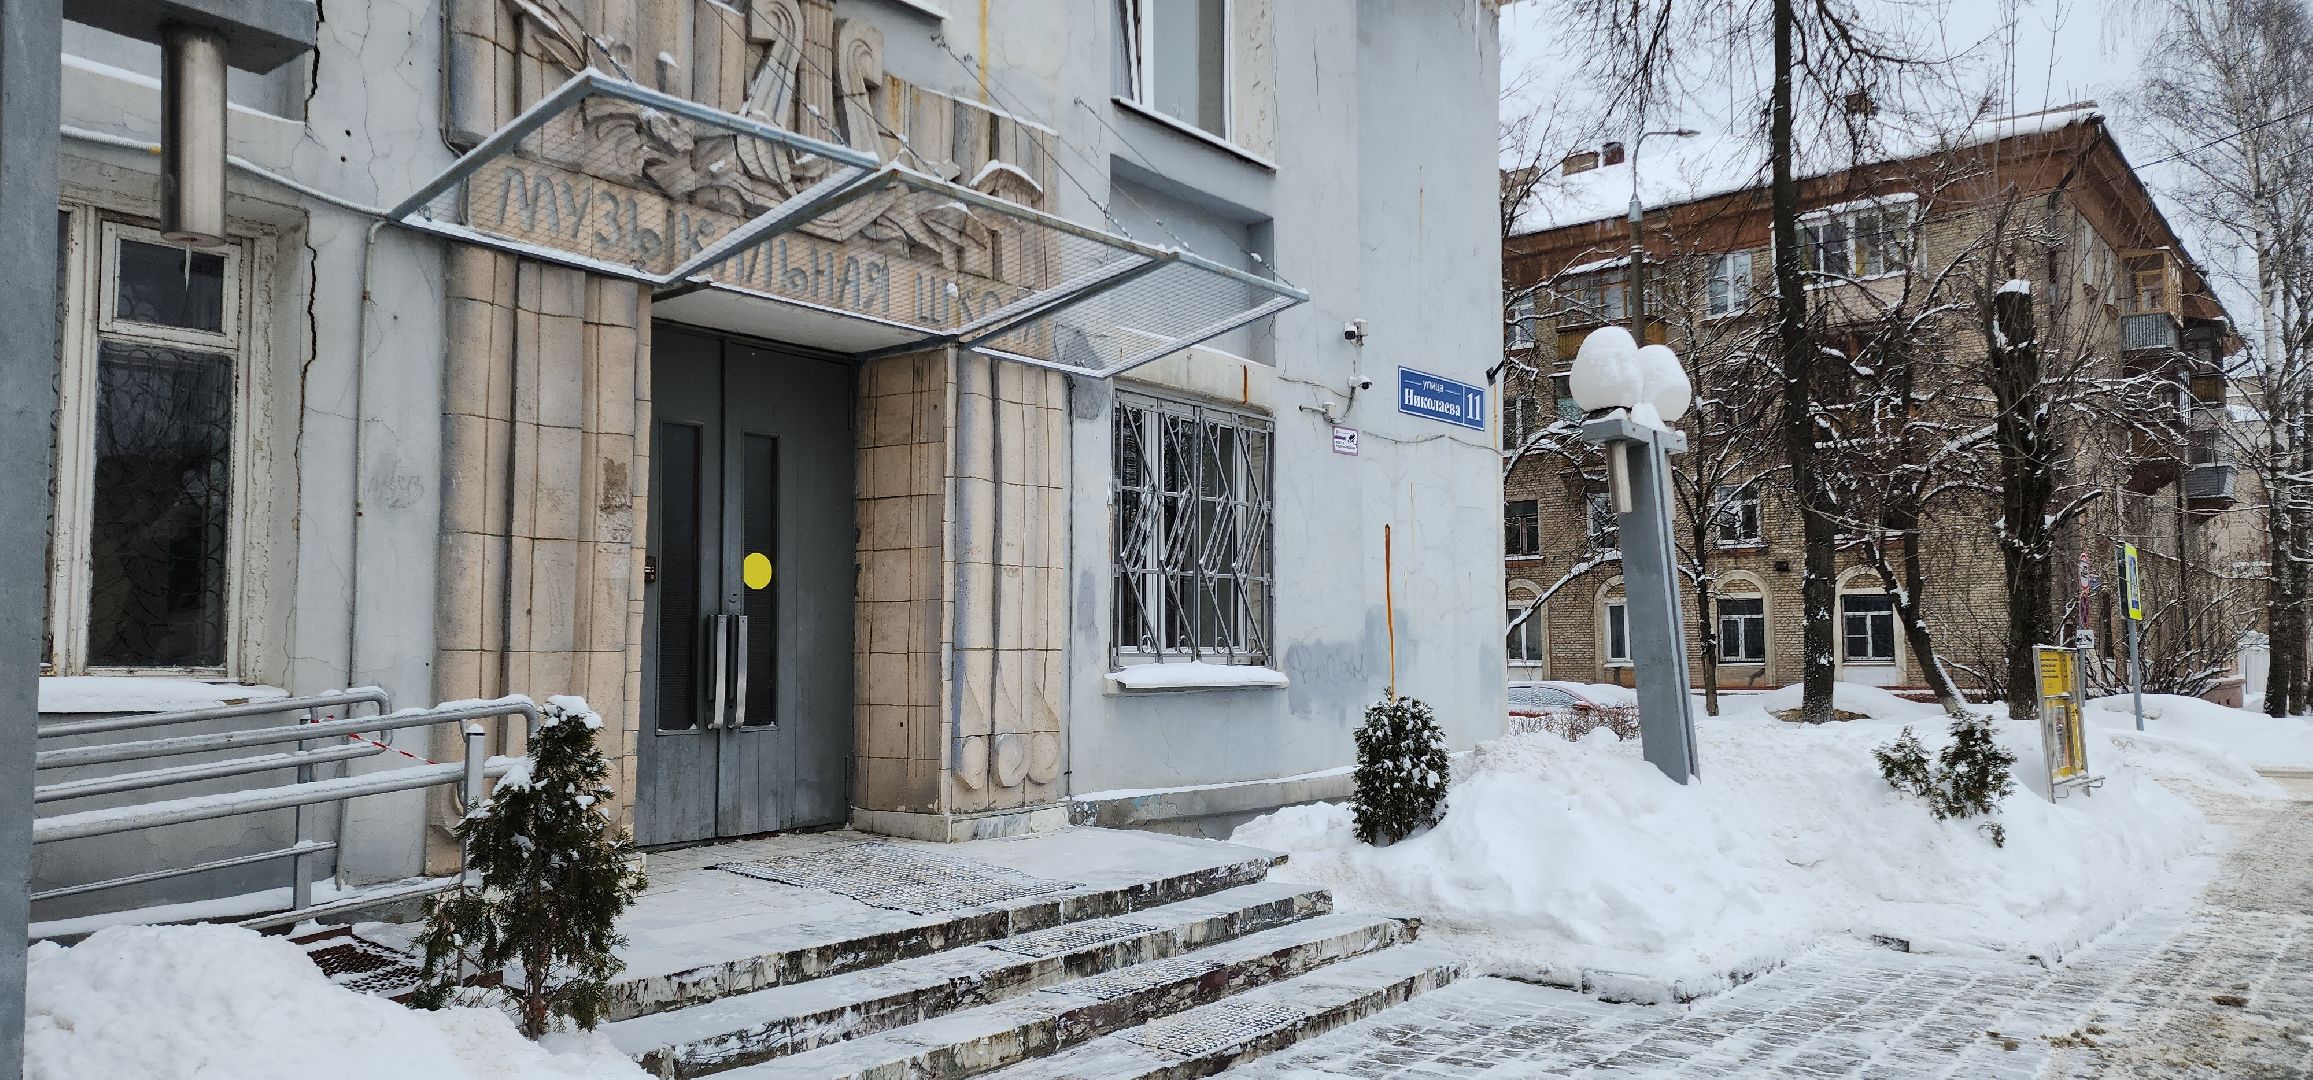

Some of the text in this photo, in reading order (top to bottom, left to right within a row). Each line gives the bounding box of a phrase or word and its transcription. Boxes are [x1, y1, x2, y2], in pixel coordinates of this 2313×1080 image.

[1423, 380, 1444, 393] улица
[1404, 388, 1481, 420] Николаева 11
